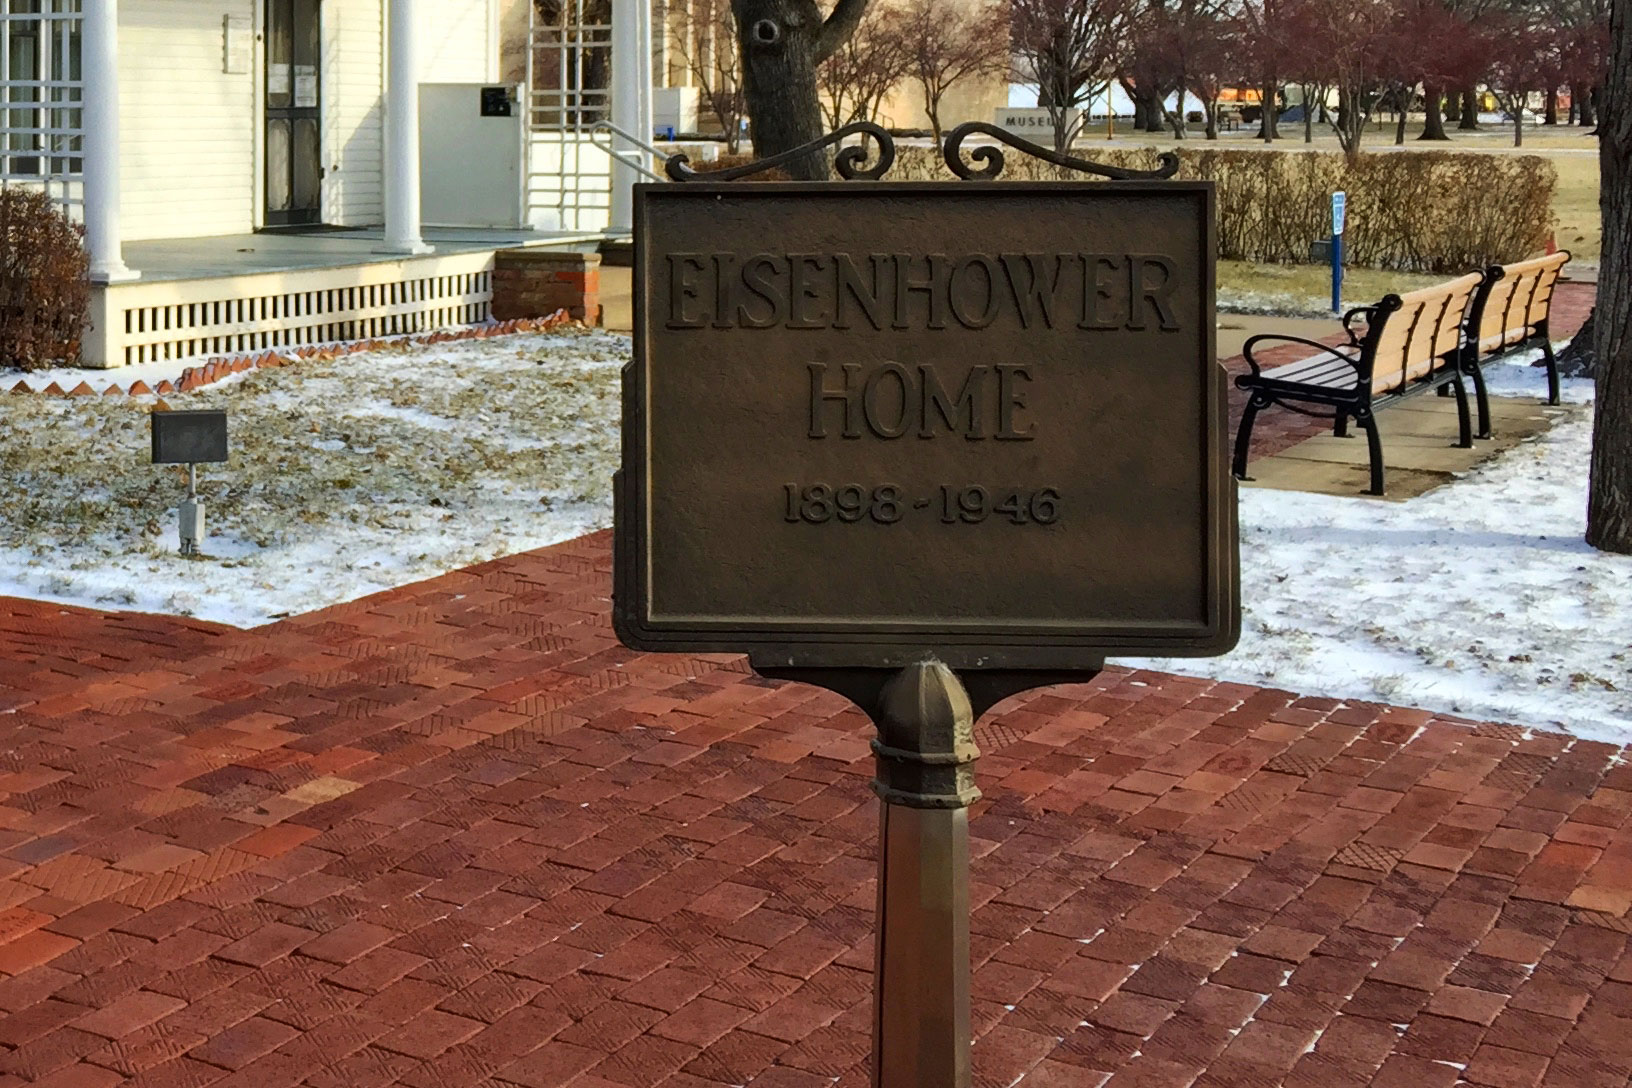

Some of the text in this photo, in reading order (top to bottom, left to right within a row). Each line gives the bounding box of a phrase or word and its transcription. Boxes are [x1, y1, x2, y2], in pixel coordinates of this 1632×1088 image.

[1005, 116, 1056, 127] MUSEU
[665, 251, 1181, 332] EISENHOWER
[807, 361, 1036, 441] HOME
